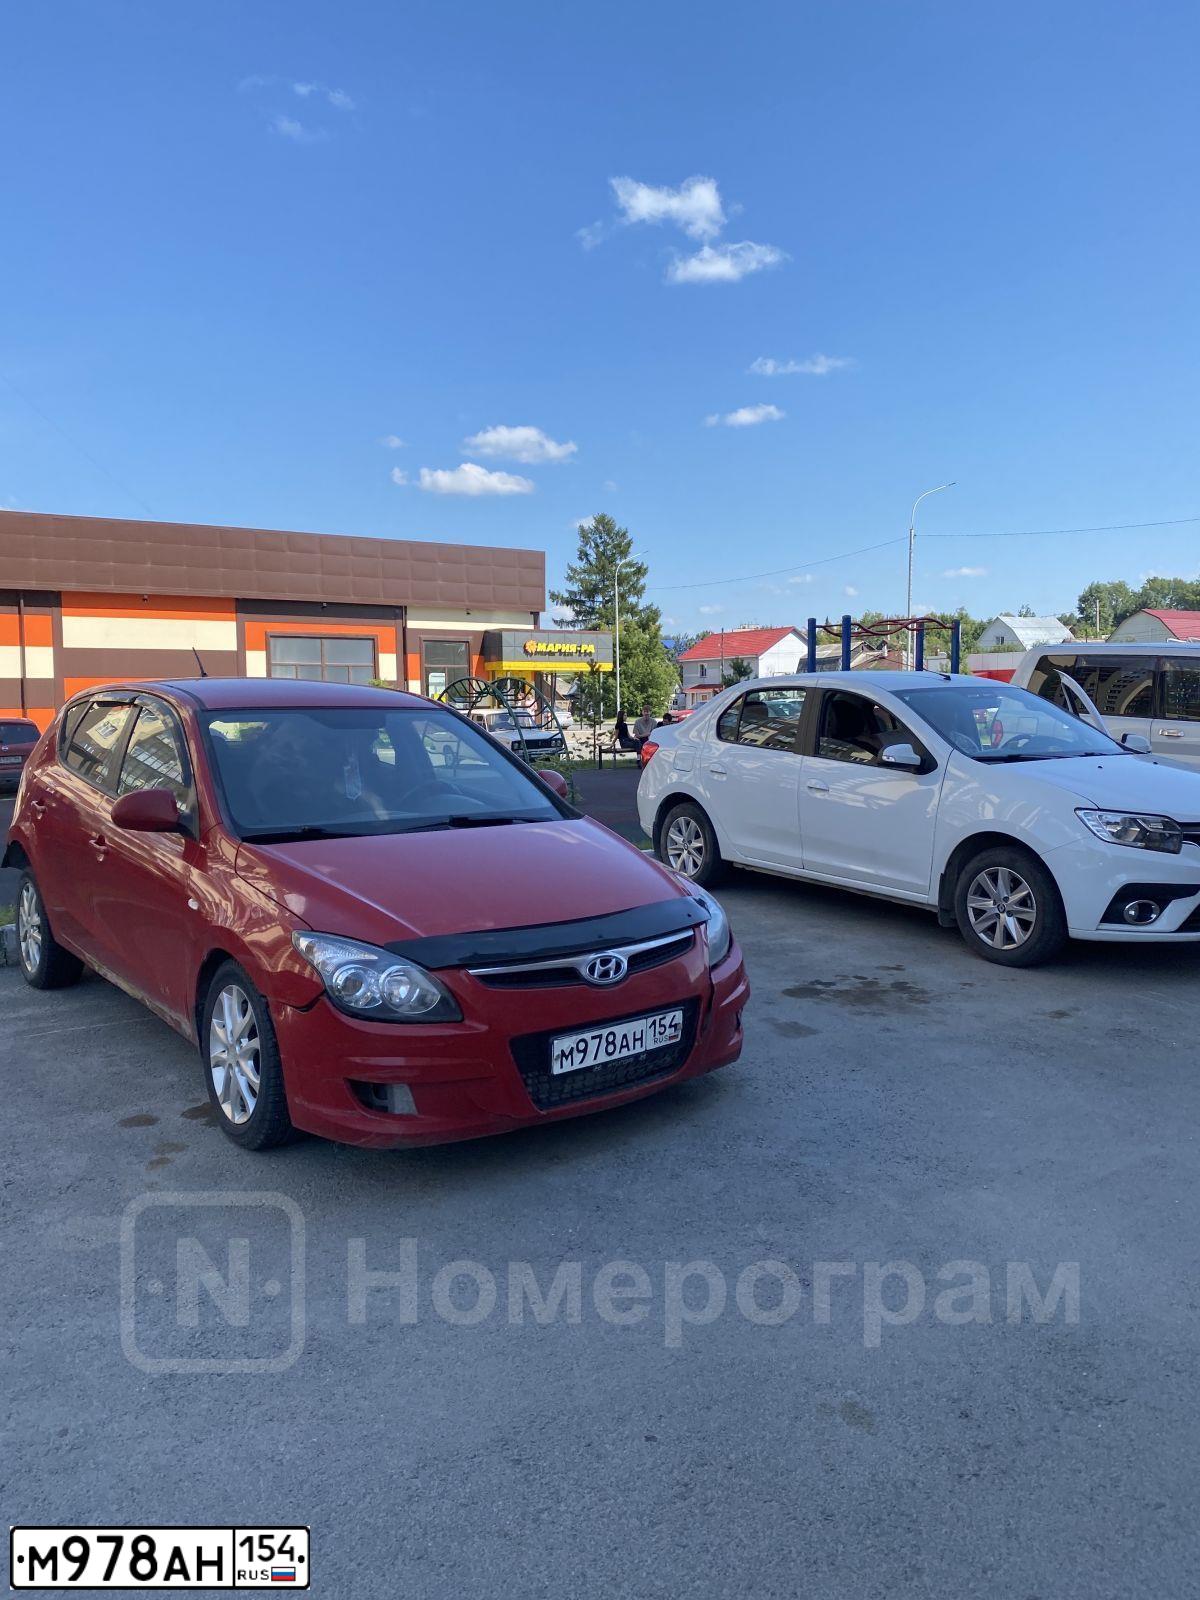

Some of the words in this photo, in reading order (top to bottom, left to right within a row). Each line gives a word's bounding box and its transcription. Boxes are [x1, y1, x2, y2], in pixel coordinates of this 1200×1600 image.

[537, 643, 595, 653] МАРИЯ-РА
[560, 1029, 644, 1069] М978АН
[648, 1014, 678, 1037] 154
[653, 1035, 668, 1044] RUS
